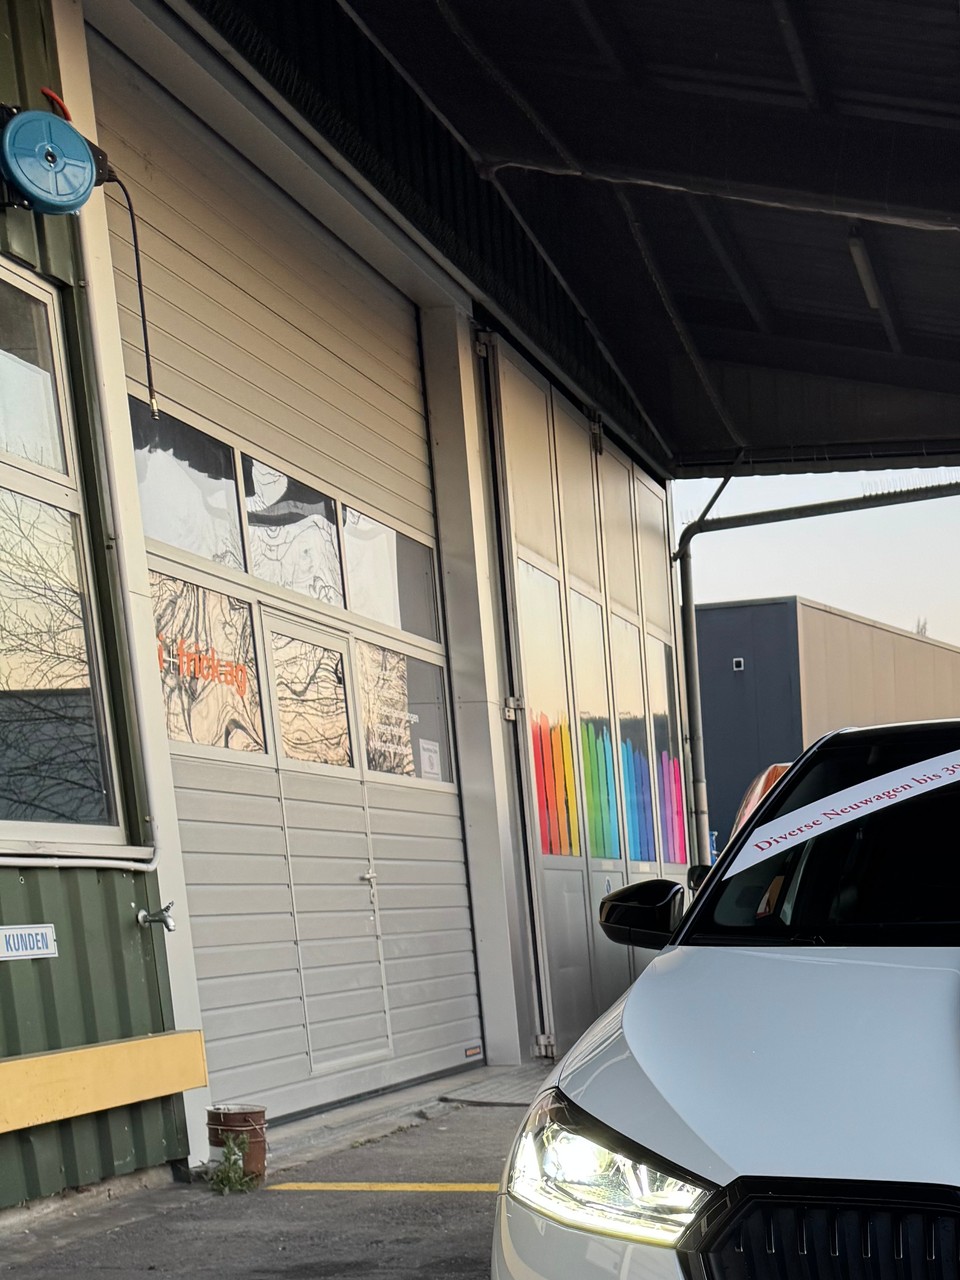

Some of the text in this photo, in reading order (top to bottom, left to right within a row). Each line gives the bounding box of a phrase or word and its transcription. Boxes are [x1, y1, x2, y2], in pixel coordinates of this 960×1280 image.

[753, 818, 823, 852] Diverse
[821, 782, 914, 821] Neuwagen
[912, 774, 942, 785] bis
[4, 932, 49, 952] KUNDEN
